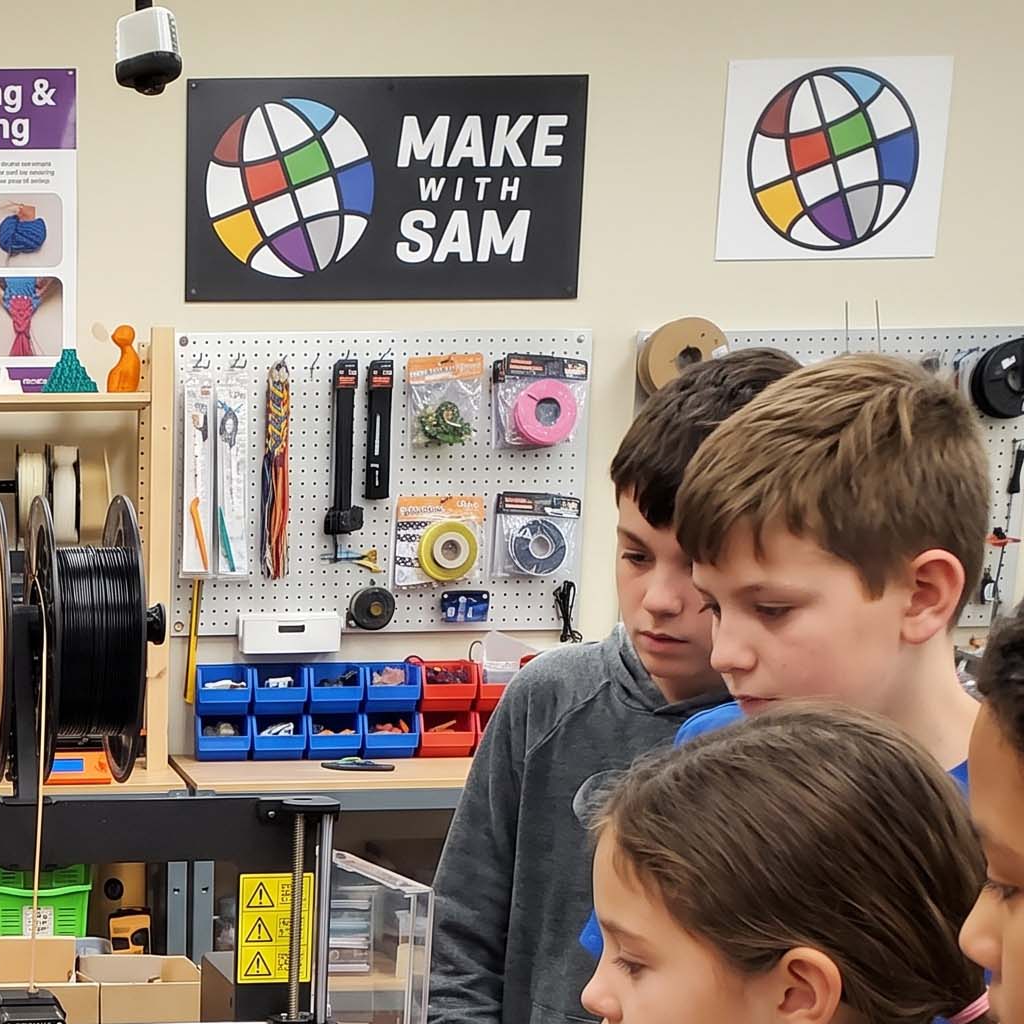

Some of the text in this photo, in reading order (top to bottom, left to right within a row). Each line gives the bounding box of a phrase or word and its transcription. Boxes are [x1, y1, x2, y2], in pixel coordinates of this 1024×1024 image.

[31, 78, 57, 106] &
[396, 115, 569, 168] MAKE
[418, 177, 521, 201] WITH
[395, 209, 532, 264] SAM
